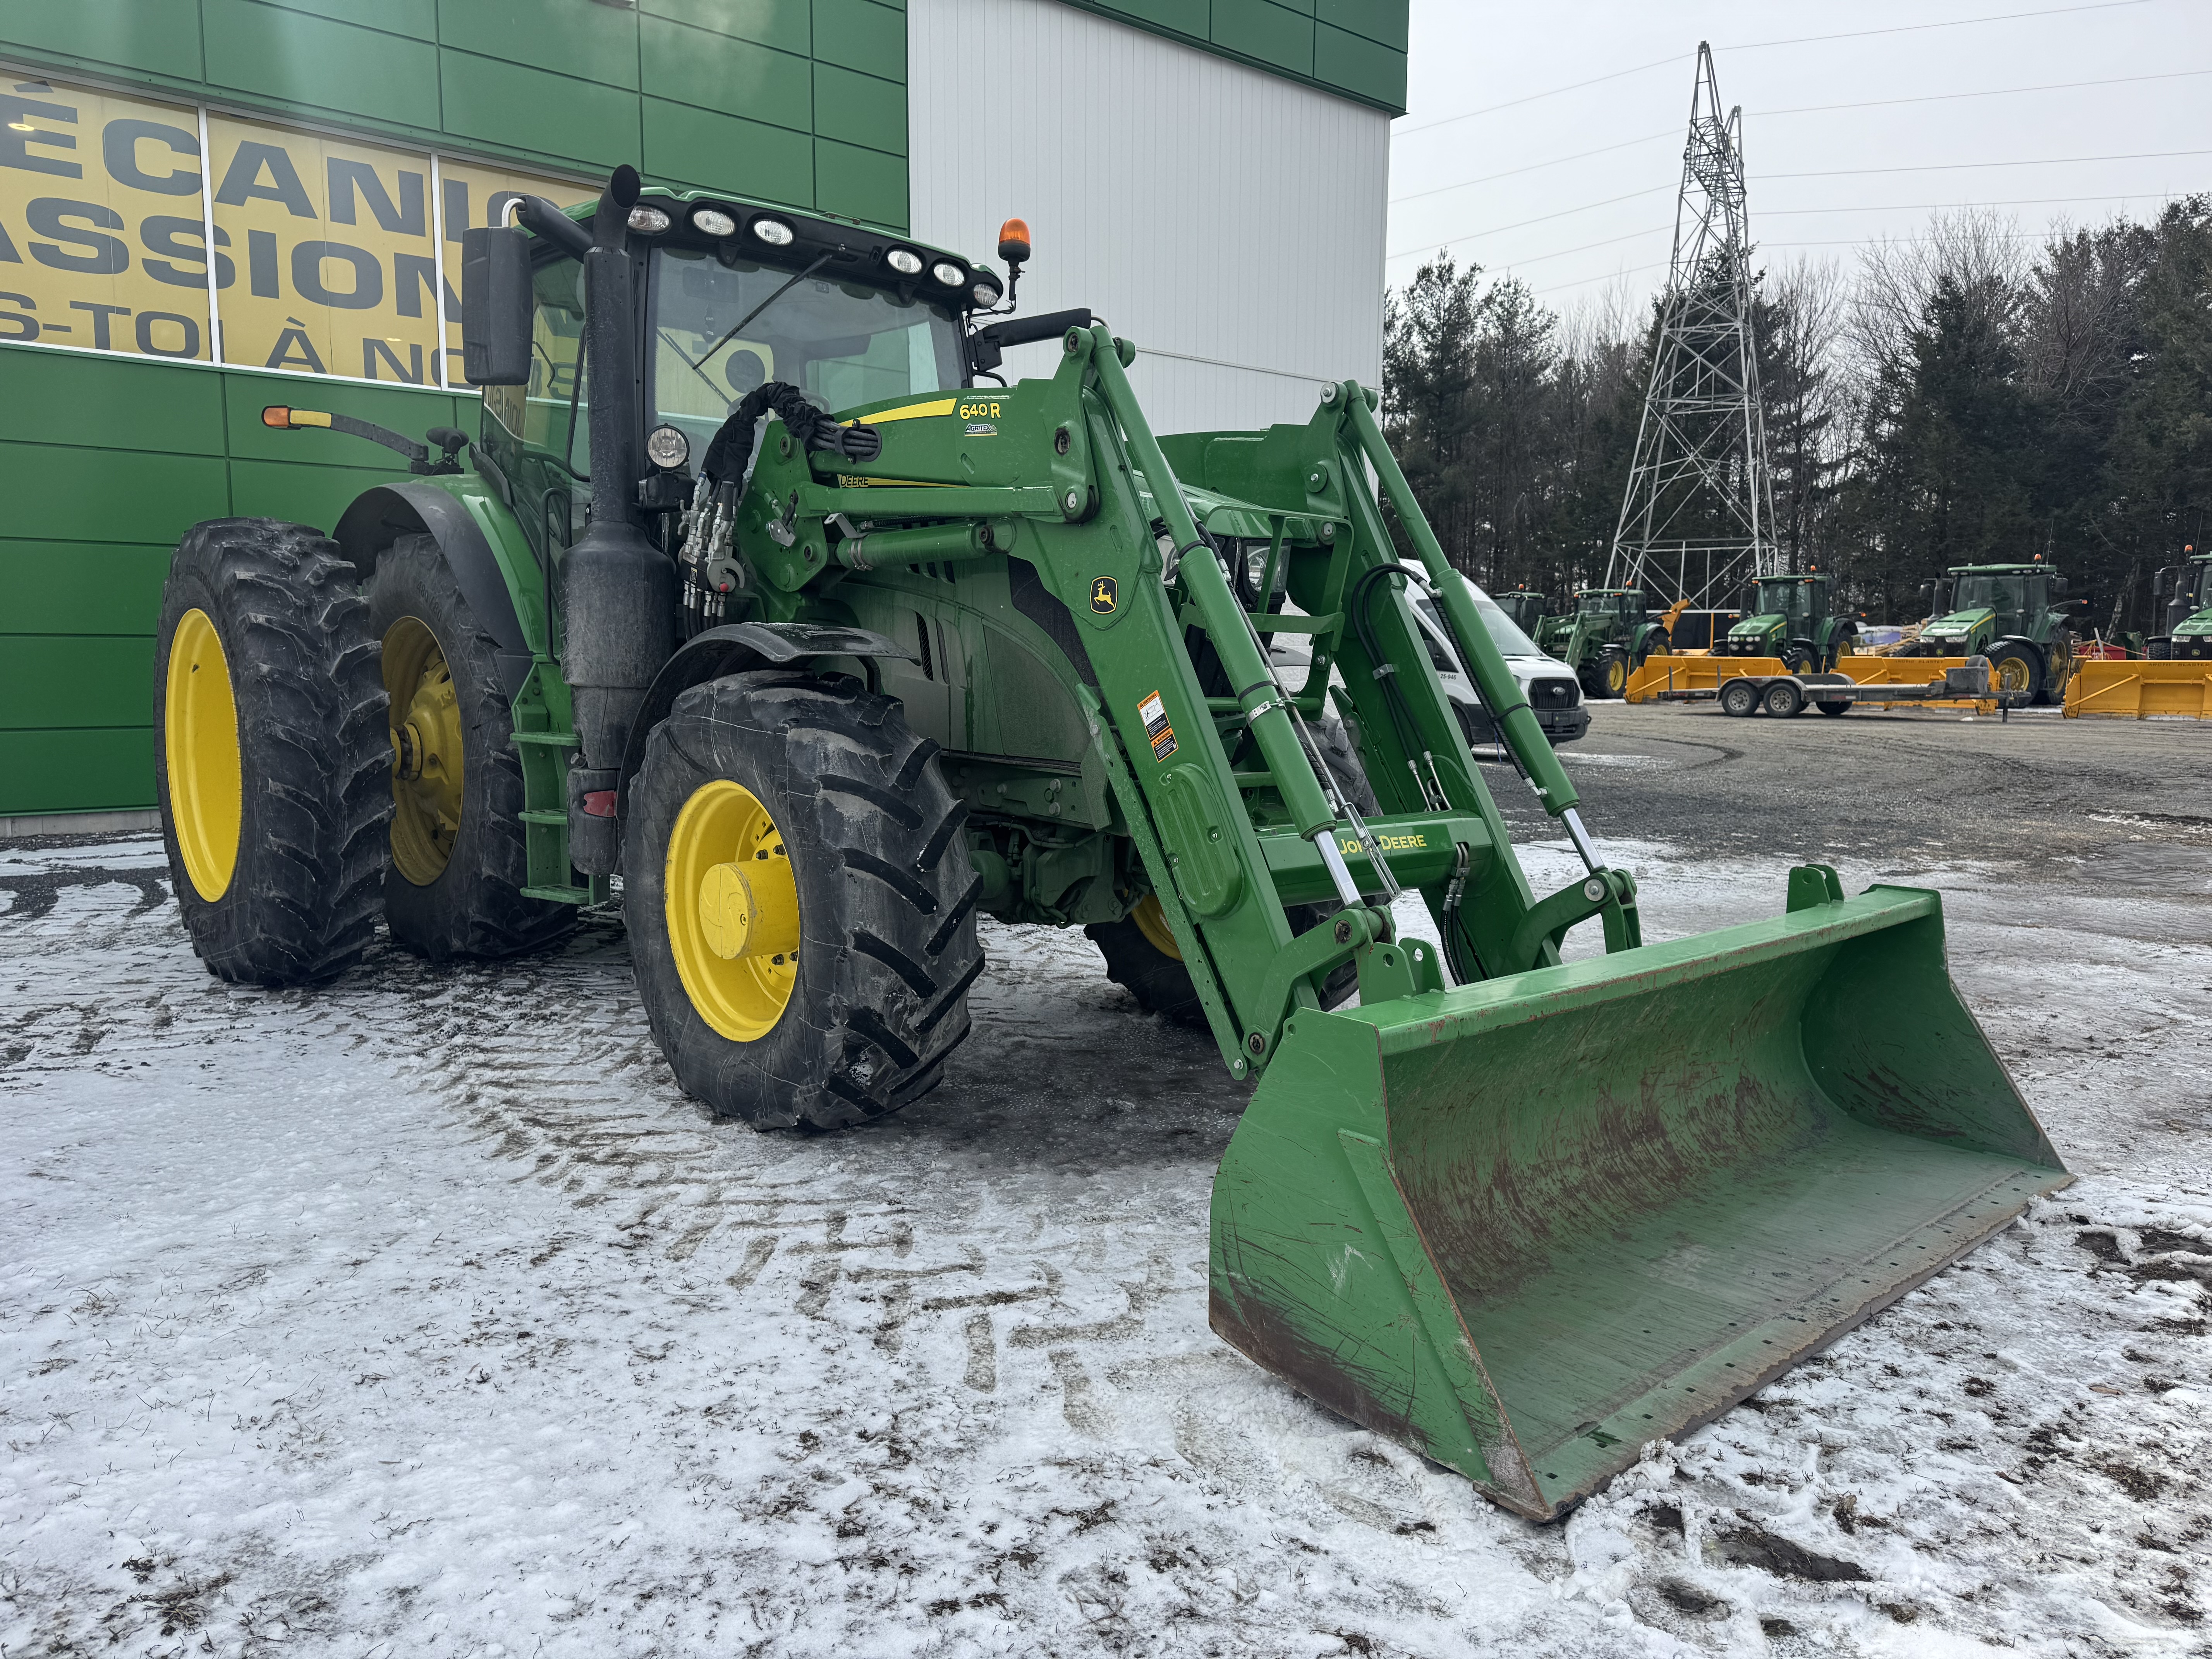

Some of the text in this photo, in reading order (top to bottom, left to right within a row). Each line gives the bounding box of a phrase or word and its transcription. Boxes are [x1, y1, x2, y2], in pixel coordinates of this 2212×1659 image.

[0, 197, 462, 323] SSION
[265, 317, 328, 374] À
[841, 474, 869, 486] DEERE
[1340, 835, 1427, 854] JO DEERE
